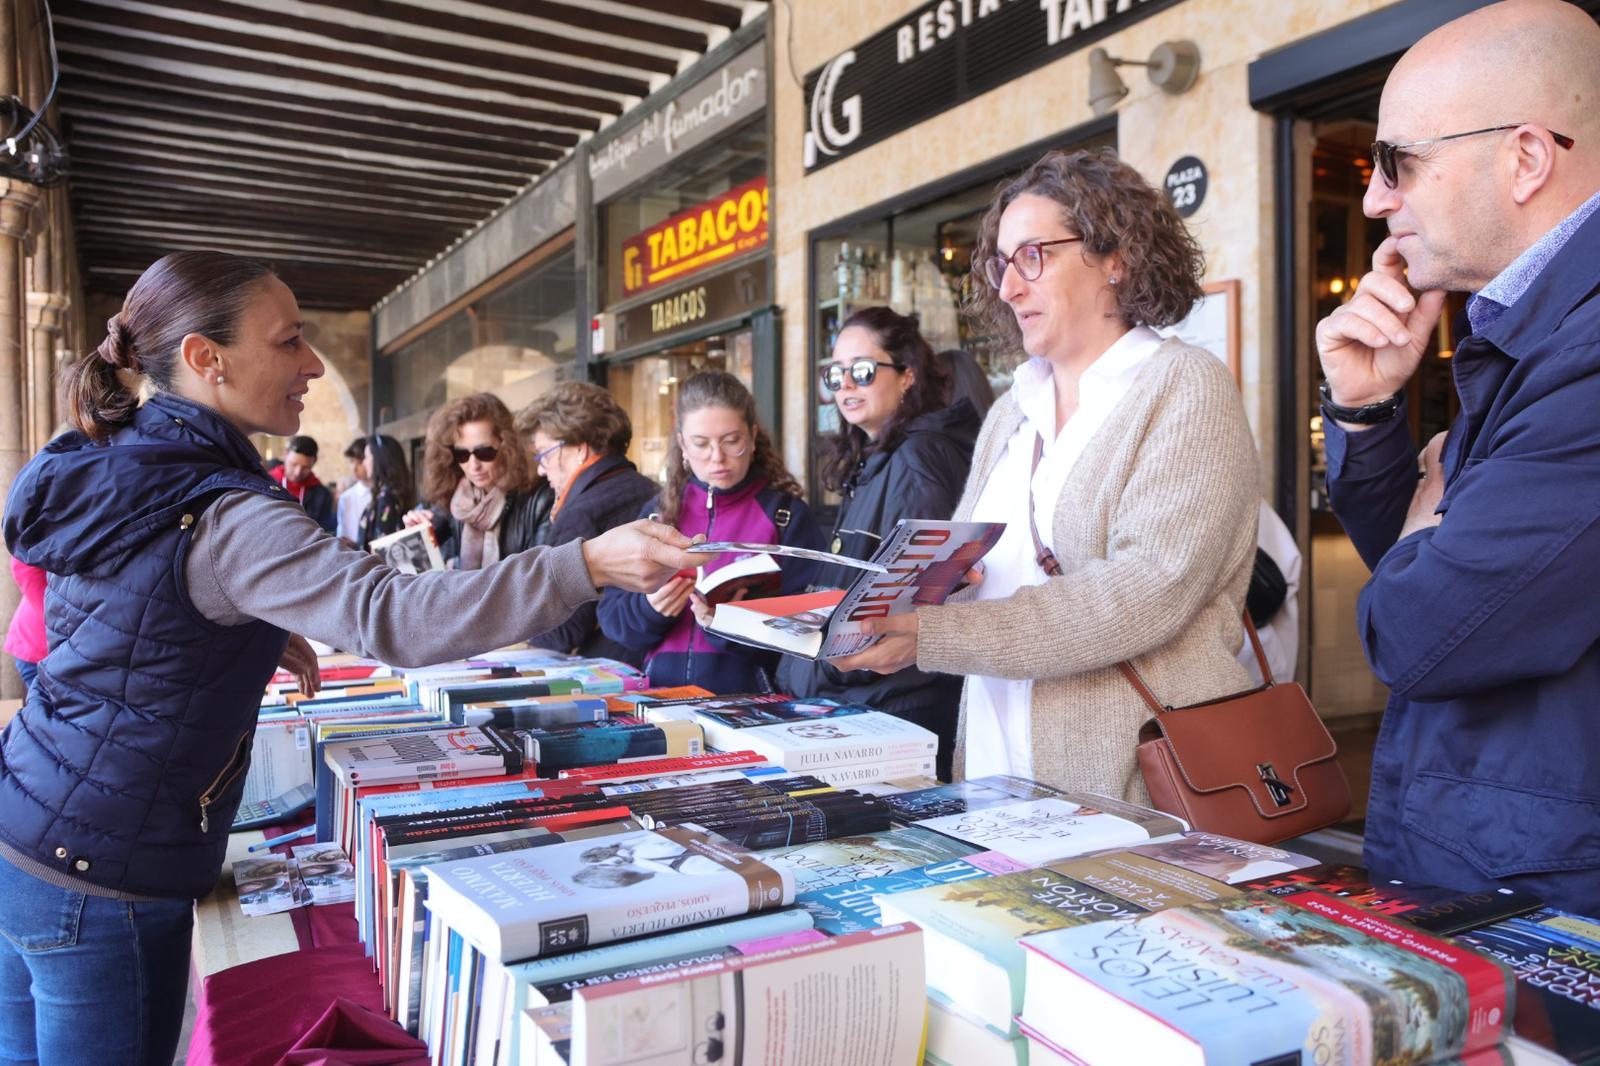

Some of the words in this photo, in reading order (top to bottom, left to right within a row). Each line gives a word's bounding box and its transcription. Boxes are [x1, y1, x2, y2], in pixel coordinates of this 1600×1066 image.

[664, 68, 759, 154] fumador
[1173, 183, 1197, 208] 23
[651, 286, 707, 332] TABACOS
[846, 529, 951, 622] DELITO
[800, 752, 830, 766] JULIA
[834, 747, 883, 761] NAVARRO
[831, 767, 880, 784] NAVARRO
[487, 861, 558, 902] HUERTA
[1083, 873, 1137, 899] VUELTA
[1109, 875, 1153, 894] CASA
[1031, 876, 1138, 921] MORTON
[1031, 890, 1096, 916] KATE
[1137, 896, 1165, 908] DE
[1155, 892, 1172, 902] A
[1306, 900, 1340, 917] 2022
[611, 918, 666, 938] HUERTA
[1341, 914, 1400, 940] PLANETA
[1400, 937, 1458, 963] PREMIO
[587, 975, 613, 987] EN
[613, 962, 677, 980] PIENSO
[1074, 945, 1212, 1012] LEJOS
[1104, 926, 1279, 1014] LUISIANA
[562, 981, 586, 991] TI
